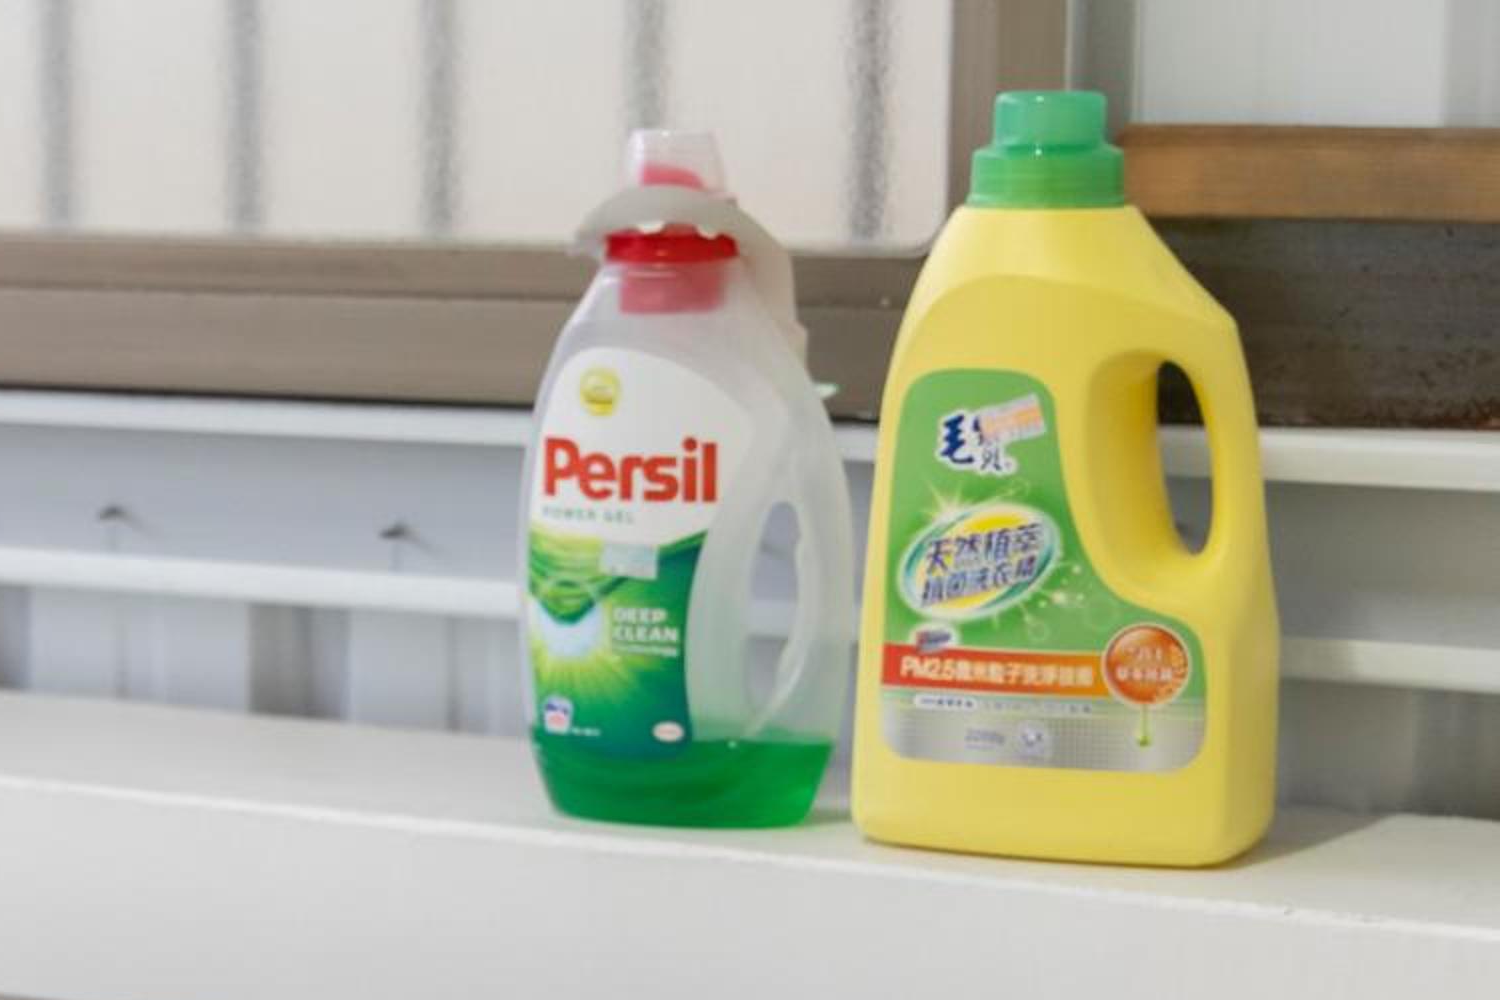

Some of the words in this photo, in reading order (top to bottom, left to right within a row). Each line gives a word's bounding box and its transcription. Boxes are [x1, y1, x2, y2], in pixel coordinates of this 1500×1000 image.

[543, 436, 719, 502] Persil
[542, 505, 597, 522] POWER
[603, 507, 635, 524] GEL
[927, 522, 1041, 574] 天然植萃
[612, 607, 668, 624] DEEP
[612, 625, 680, 644] CLEAN
